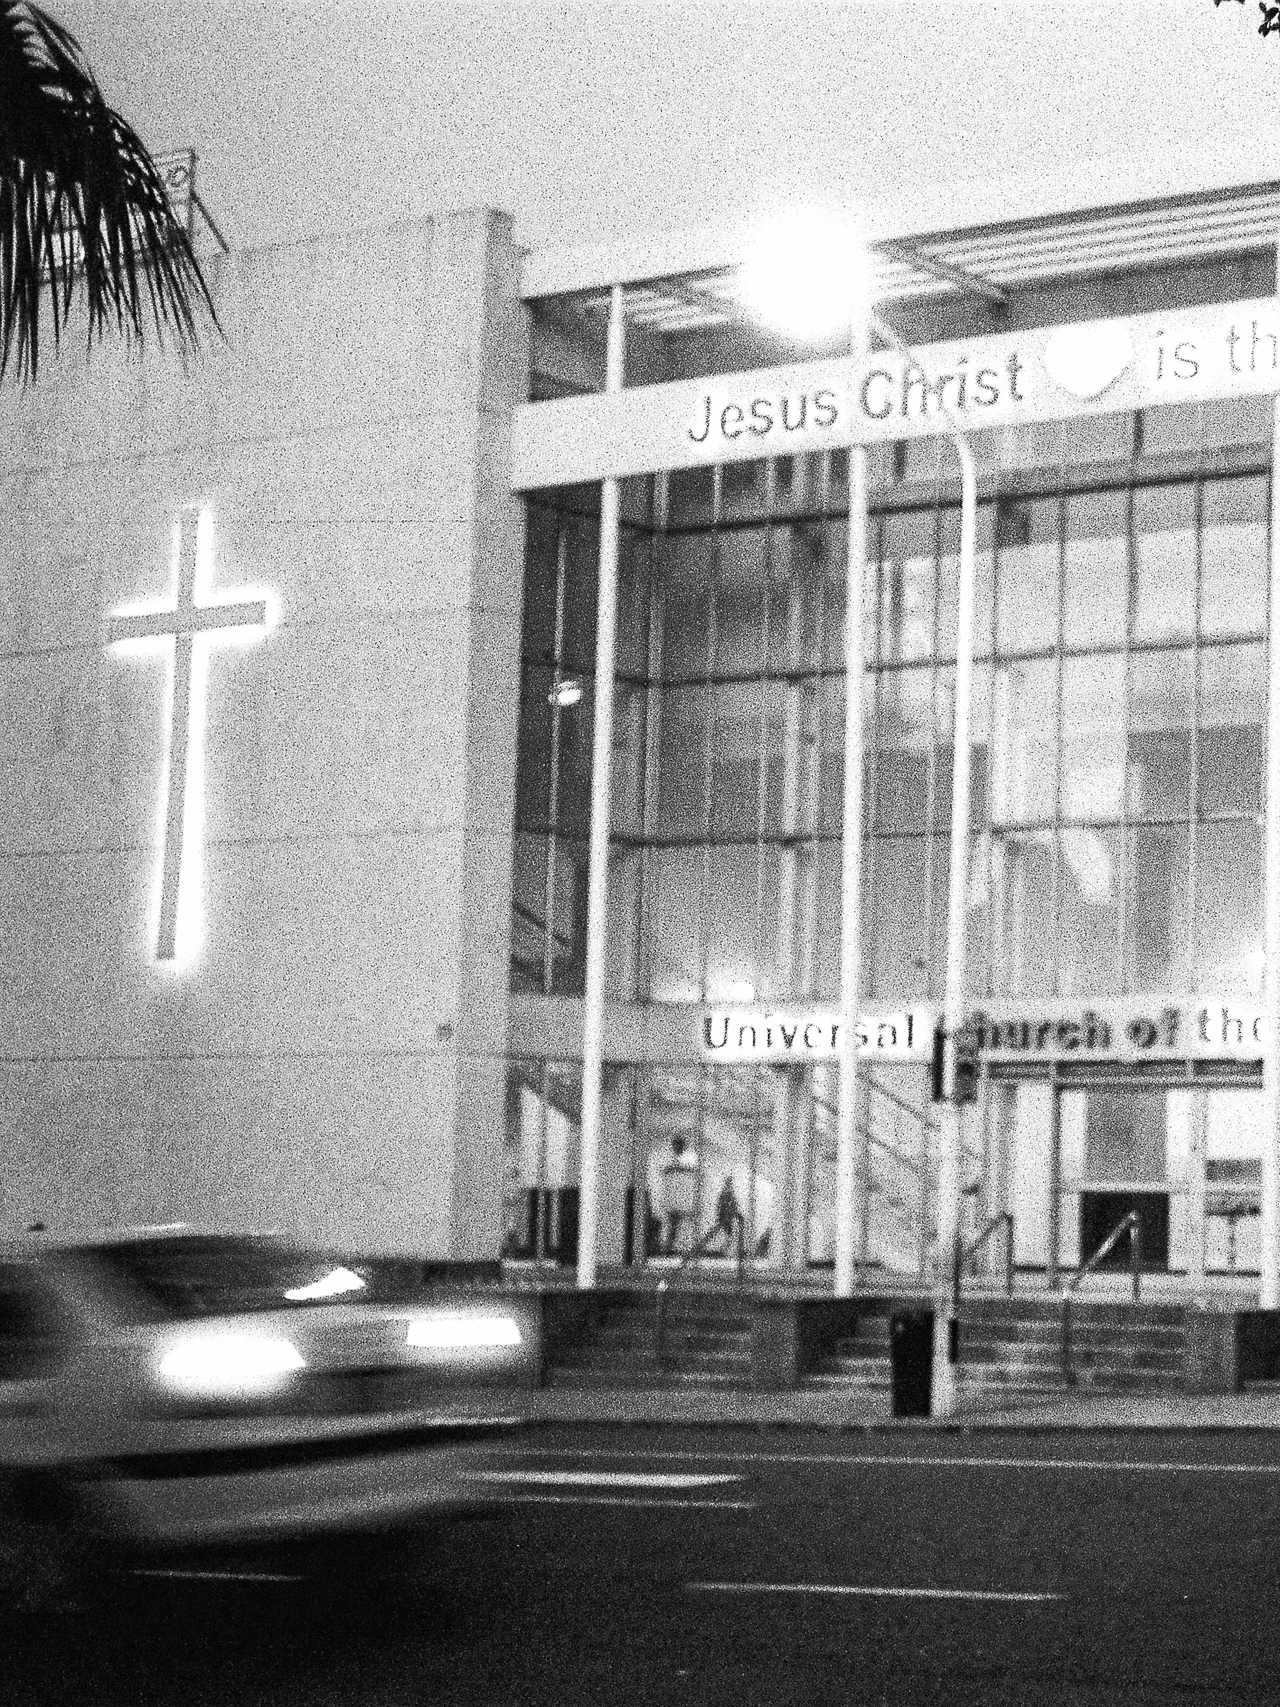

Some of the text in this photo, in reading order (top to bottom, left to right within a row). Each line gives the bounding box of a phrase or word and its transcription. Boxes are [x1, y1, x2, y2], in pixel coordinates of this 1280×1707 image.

[688, 389, 839, 442] Jesus
[860, 351, 1024, 420] Christ
[1155, 330, 1201, 382] is
[703, 1013, 914, 1049] Universal
[958, 1009, 1112, 1051] hurch
[1126, 1006, 1180, 1049] of
